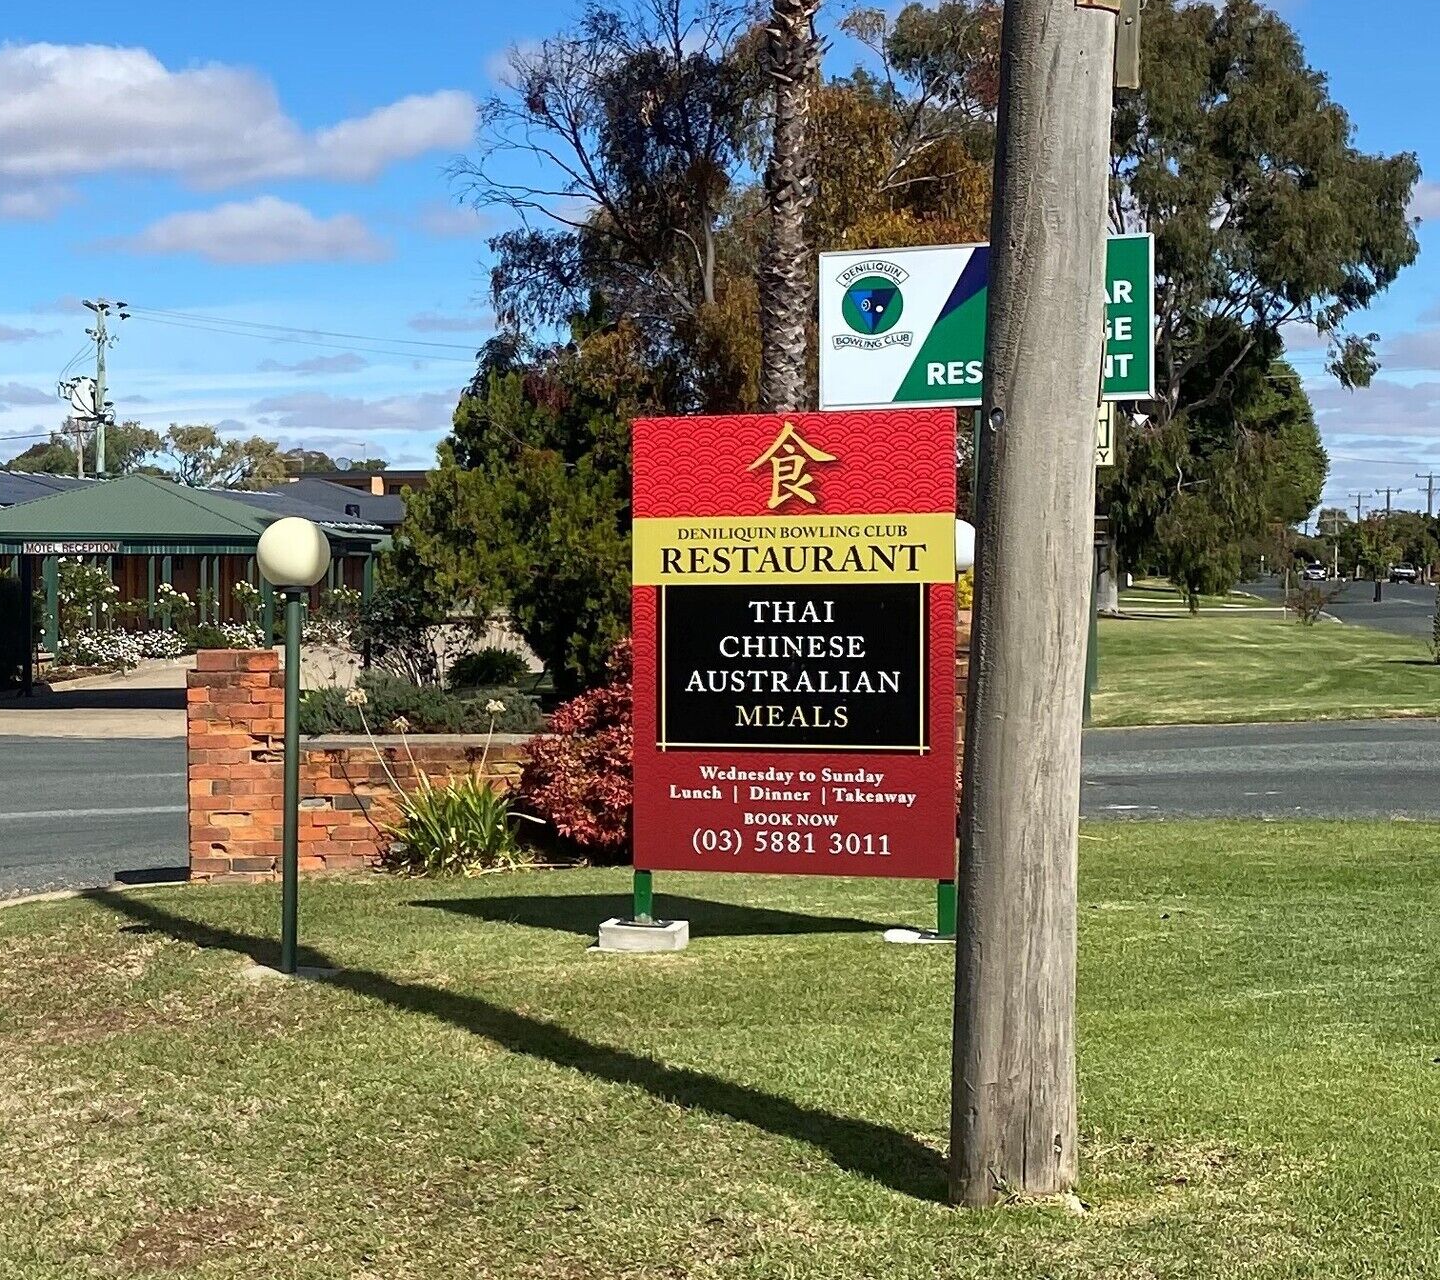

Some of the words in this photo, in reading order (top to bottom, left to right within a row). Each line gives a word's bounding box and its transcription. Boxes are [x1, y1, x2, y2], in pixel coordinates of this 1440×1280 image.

[842, 262, 902, 281] DENILIQUIN
[835, 336, 882, 349] BOWLING
[884, 333, 910, 345] CLUB
[746, 421, 838, 510] 食
[678, 527, 777, 542] DENILIQUIN
[780, 526, 860, 539] BOWLING
[863, 525, 908, 538] CLUB
[26, 543, 55, 554] MOTEL
[62, 543, 117, 554] RECEPTION
[660, 544, 927, 575] RESTAURANT
[748, 601, 835, 623] THAI
[719, 636, 866, 658] CHINESE
[685, 670, 901, 693] AUSTRALIAN
[735, 705, 849, 728] MEALS
[699, 766, 794, 785] Wednesday
[799, 771, 816, 782] to
[821, 768, 884, 787] Sunday
[669, 785, 722, 800] Lunch
[749, 786, 811, 801] Dinner
[832, 788, 917, 807] Takeaway
[744, 813, 793, 826] BOOK
[797, 814, 839, 827] NOW
[692, 828, 742, 855] (03)
[754, 831, 816, 853] 5881
[829, 833, 891, 855] 3011
